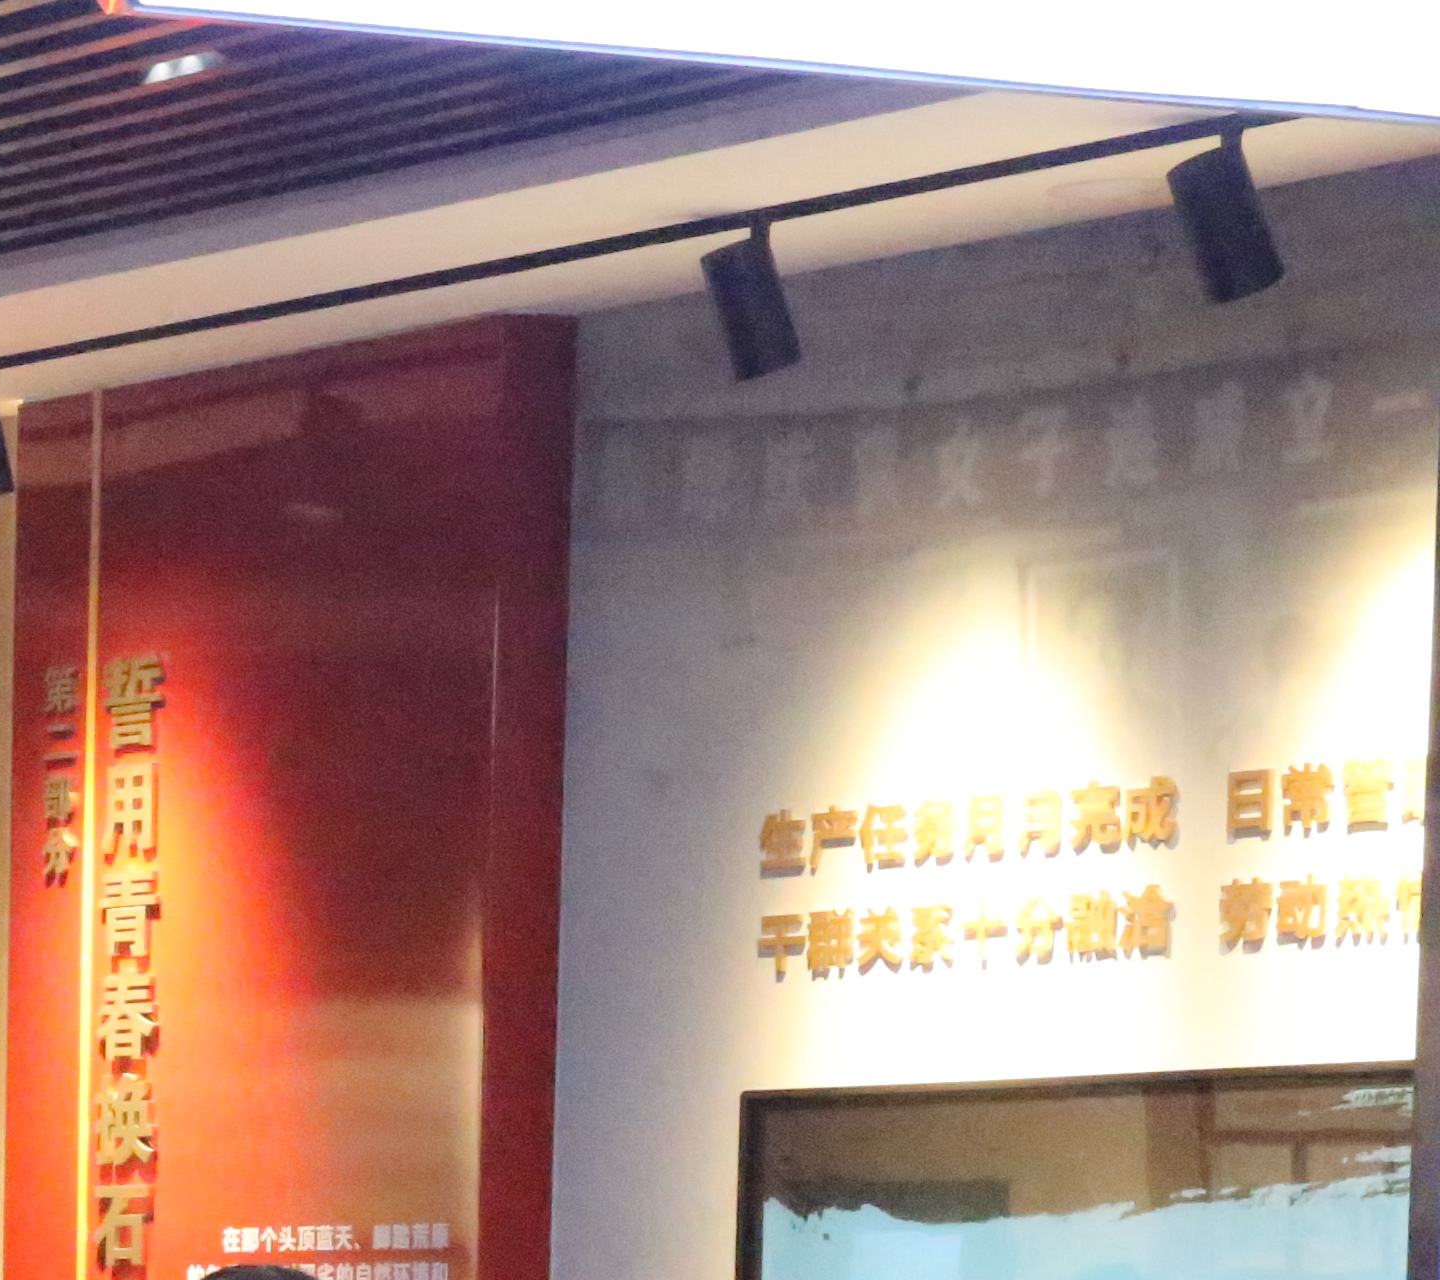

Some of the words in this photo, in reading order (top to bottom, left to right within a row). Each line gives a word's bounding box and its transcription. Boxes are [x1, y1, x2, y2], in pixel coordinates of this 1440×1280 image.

[44, 664, 79, 876] 第二部分
[759, 776, 1178, 876] 生产任务月月完成
[757, 885, 1176, 981] 干群关系十分融洽
